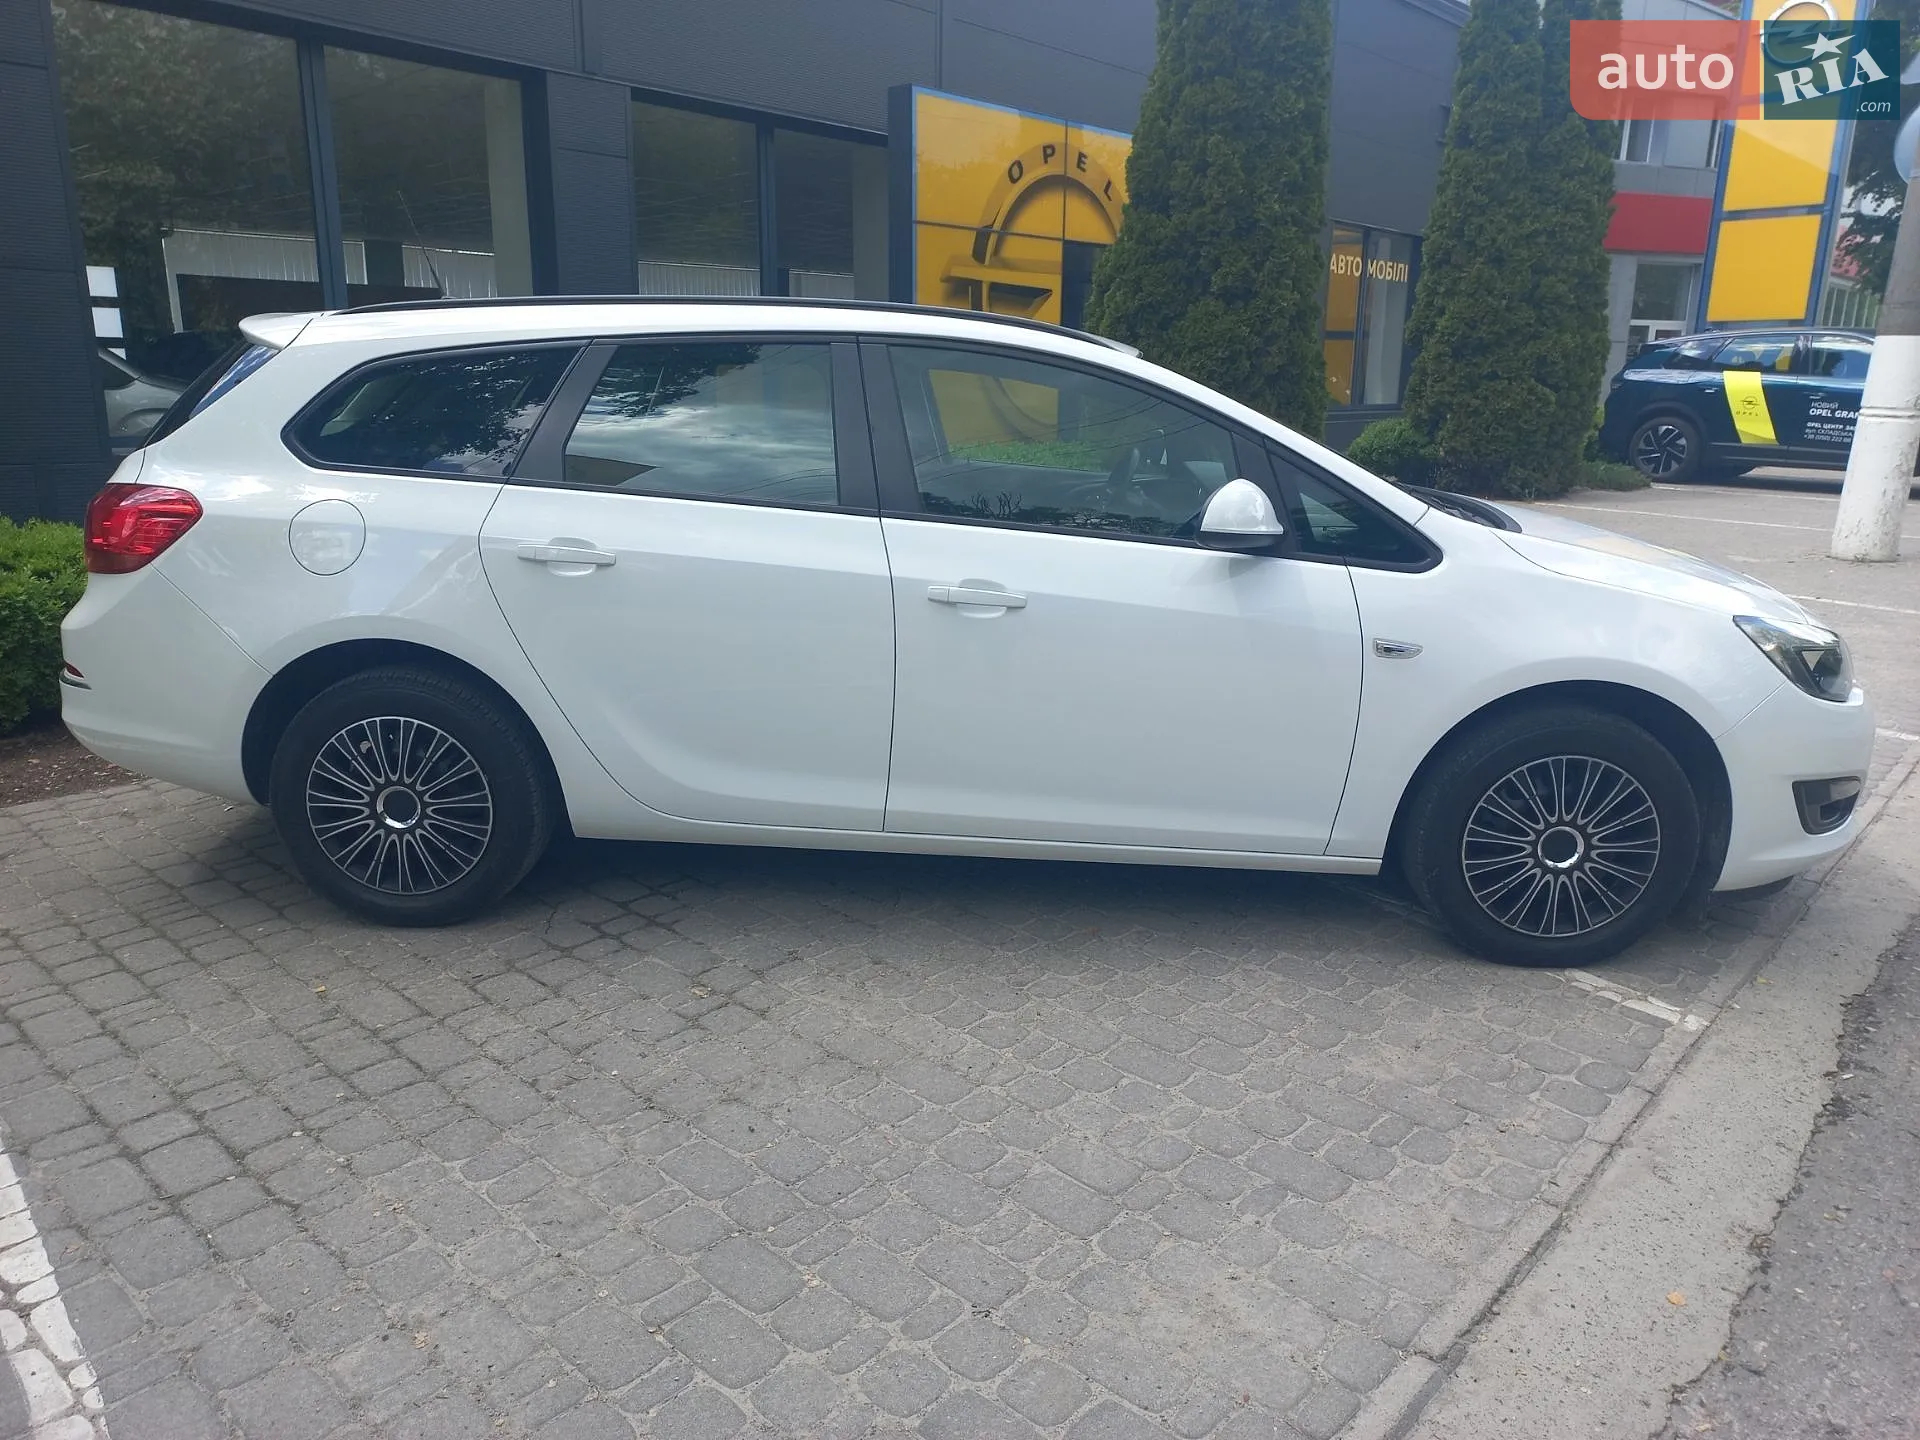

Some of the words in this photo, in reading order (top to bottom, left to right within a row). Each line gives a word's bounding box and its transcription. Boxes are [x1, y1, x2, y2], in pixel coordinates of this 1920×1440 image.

[1007, 143, 1113, 202] OPEL
[1811, 401, 1839, 409] НОВИЙ
[1809, 408, 1832, 417] OPEL
